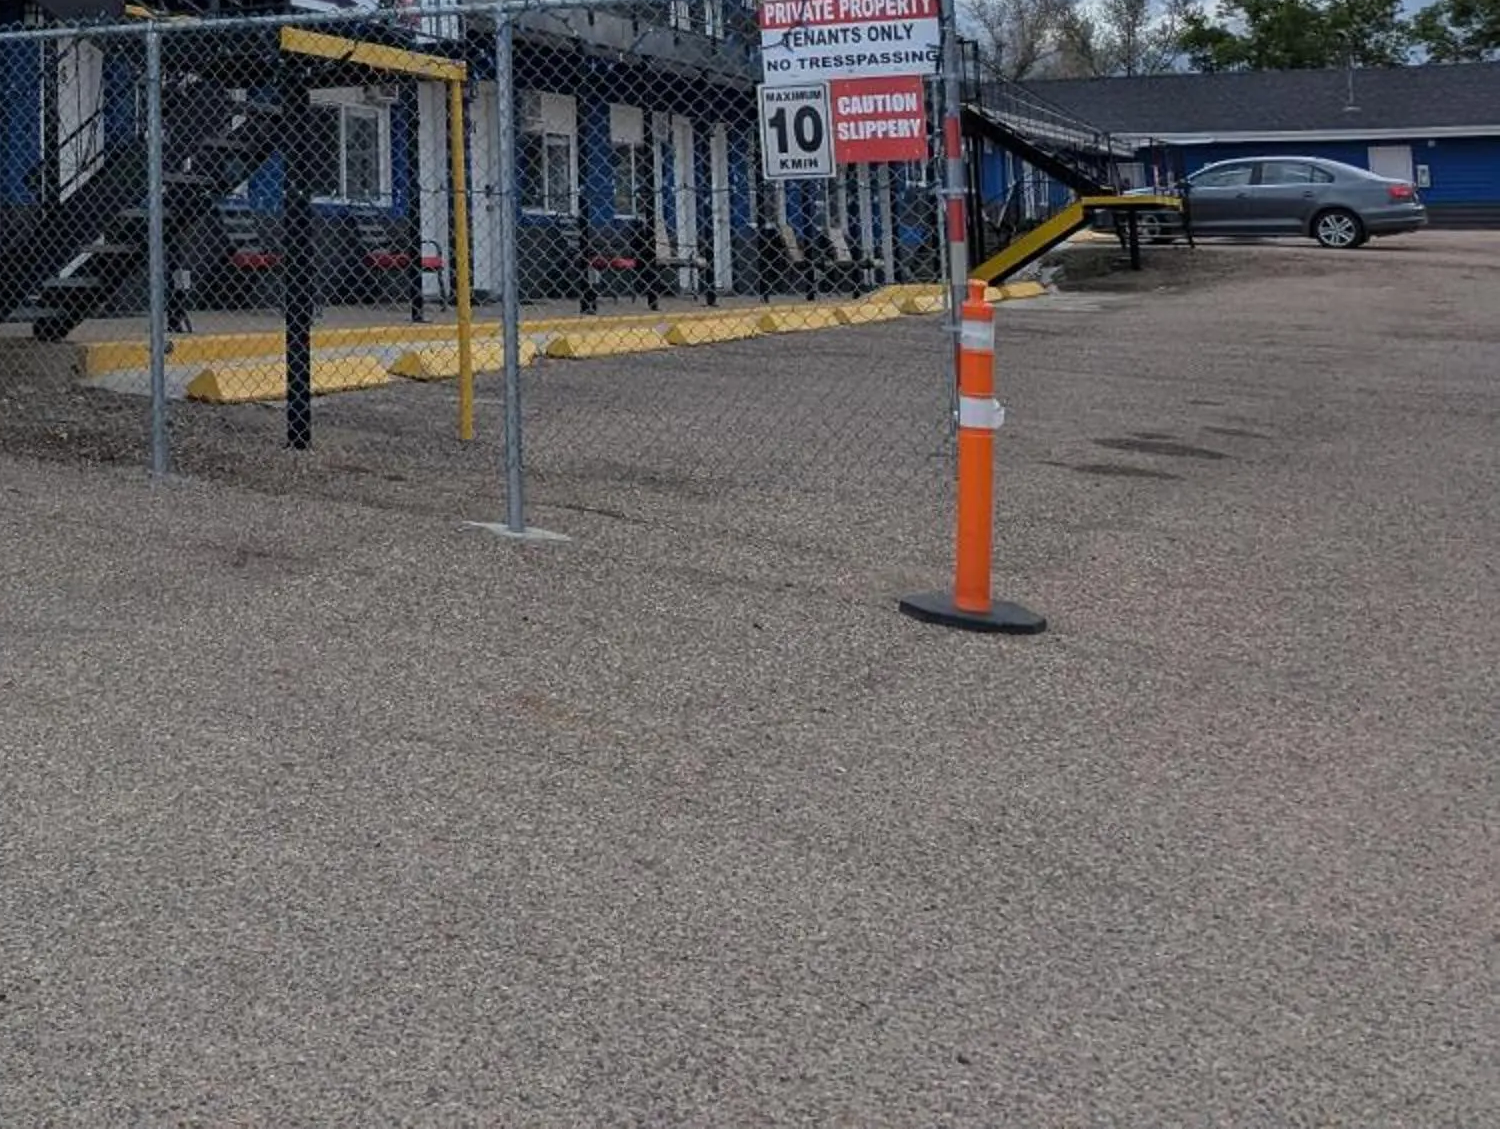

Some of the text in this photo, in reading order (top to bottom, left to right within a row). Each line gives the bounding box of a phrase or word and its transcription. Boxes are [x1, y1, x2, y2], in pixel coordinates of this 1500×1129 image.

[783, 23, 915, 49] TENANTS ONLY
[767, 49, 939, 71] NO TRESSPASSING
[765, 90, 822, 102] MAXIMUM
[837, 93, 918, 115] CAUTION
[768, 105, 823, 154] 10
[837, 119, 921, 140] SLIPPERY
